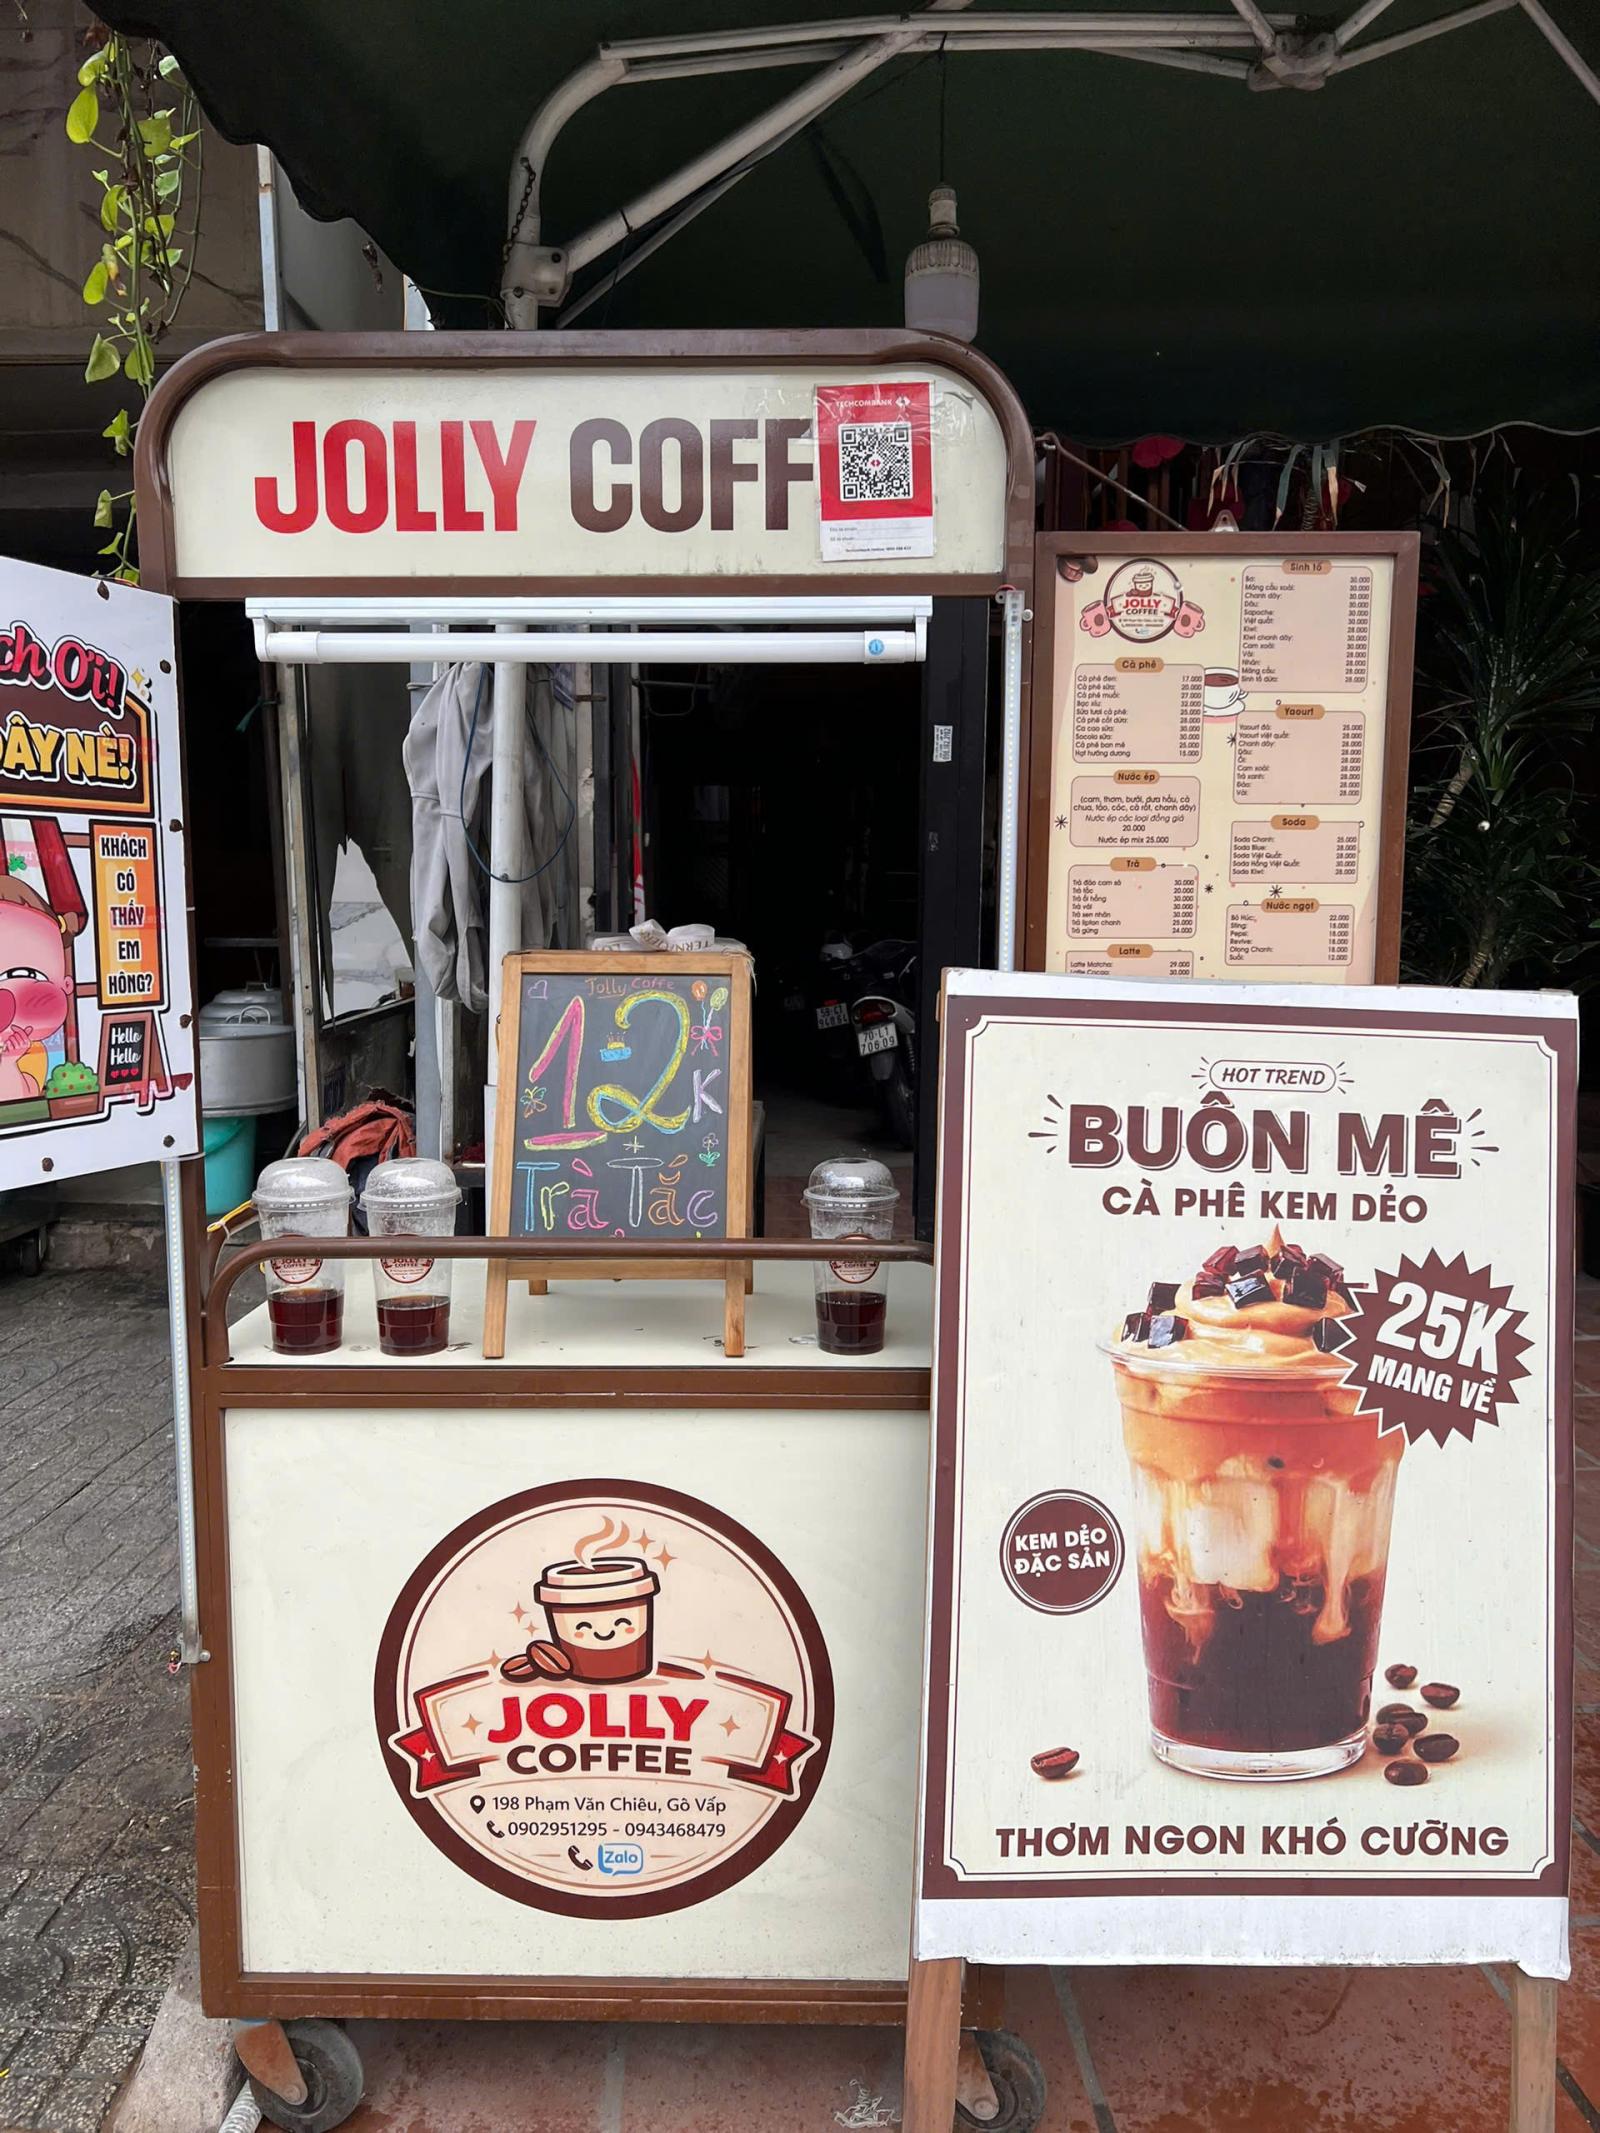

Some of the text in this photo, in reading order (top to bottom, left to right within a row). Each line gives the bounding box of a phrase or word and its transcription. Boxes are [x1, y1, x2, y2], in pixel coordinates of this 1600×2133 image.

[836, 399, 892, 407] TECHCOMBANK
[255, 418, 815, 534] JOLLY COFF
[1291, 563, 1322, 571] Sinh tố
[1123, 599, 1161, 608] JOLLY
[55, 640, 119, 708] Ơi!
[1122, 660, 1157, 669] Cà phê
[1089, 675, 1101, 683] phê
[1285, 707, 1314, 716] Yaourt
[0, 715, 130, 780] ÂY NÈ!
[1086, 741, 1099, 749] phê
[1118, 772, 1155, 782] Nước ép
[1085, 814, 1105, 822] Nước
[1107, 814, 1116, 823] ép
[1172, 814, 1184, 823] giá
[1282, 818, 1306, 826] Soda
[101, 834, 147, 858] KHÁCH
[1119, 836, 1129, 845] ép
[1126, 860, 1139, 868] Trà
[117, 869, 135, 891] CÓ
[110, 900, 144, 926] THẤY
[1266, 901, 1314, 912] Nước ngọt
[118, 940, 140, 960] EM
[1119, 947, 1140, 955] Latte
[108, 972, 153, 994] HÔNG?
[585, 977, 627, 999] Jolly
[111, 1027, 142, 1045] Hello
[110, 1048, 141, 1065] Hello
[1221, 1066, 1326, 1086] HOT TREND
[1069, 1090, 1463, 1180] BUÔN MÊ
[1101, 1177, 1428, 1224] CÀ PHÊ KEM DẺO
[1375, 1281, 1515, 1375] 25K
[1367, 1354, 1497, 1414] MANG VỀ
[1015, 1523, 1107, 1552] KEM DẺO
[1014, 1547, 1110, 1577] ĐẶC SẢN
[487, 1693, 709, 1744] JOLLY
[506, 1744, 693, 1776] COFFEE
[492, 1796, 520, 1812] 198
[524, 1796, 570, 1815] Phạm
[575, 1796, 605, 1813] Văn
[610, 1796, 662, 1816] Chiêu,
[695, 1795, 727, 1816] Vấp
[508, 1822, 608, 1838] 0902951295
[624, 1823, 726, 1838] 0943468479
[996, 1817, 1509, 1858] THƠM NGON KHÓ CƯỠNG
[604, 1850, 638, 1865] Zalo
